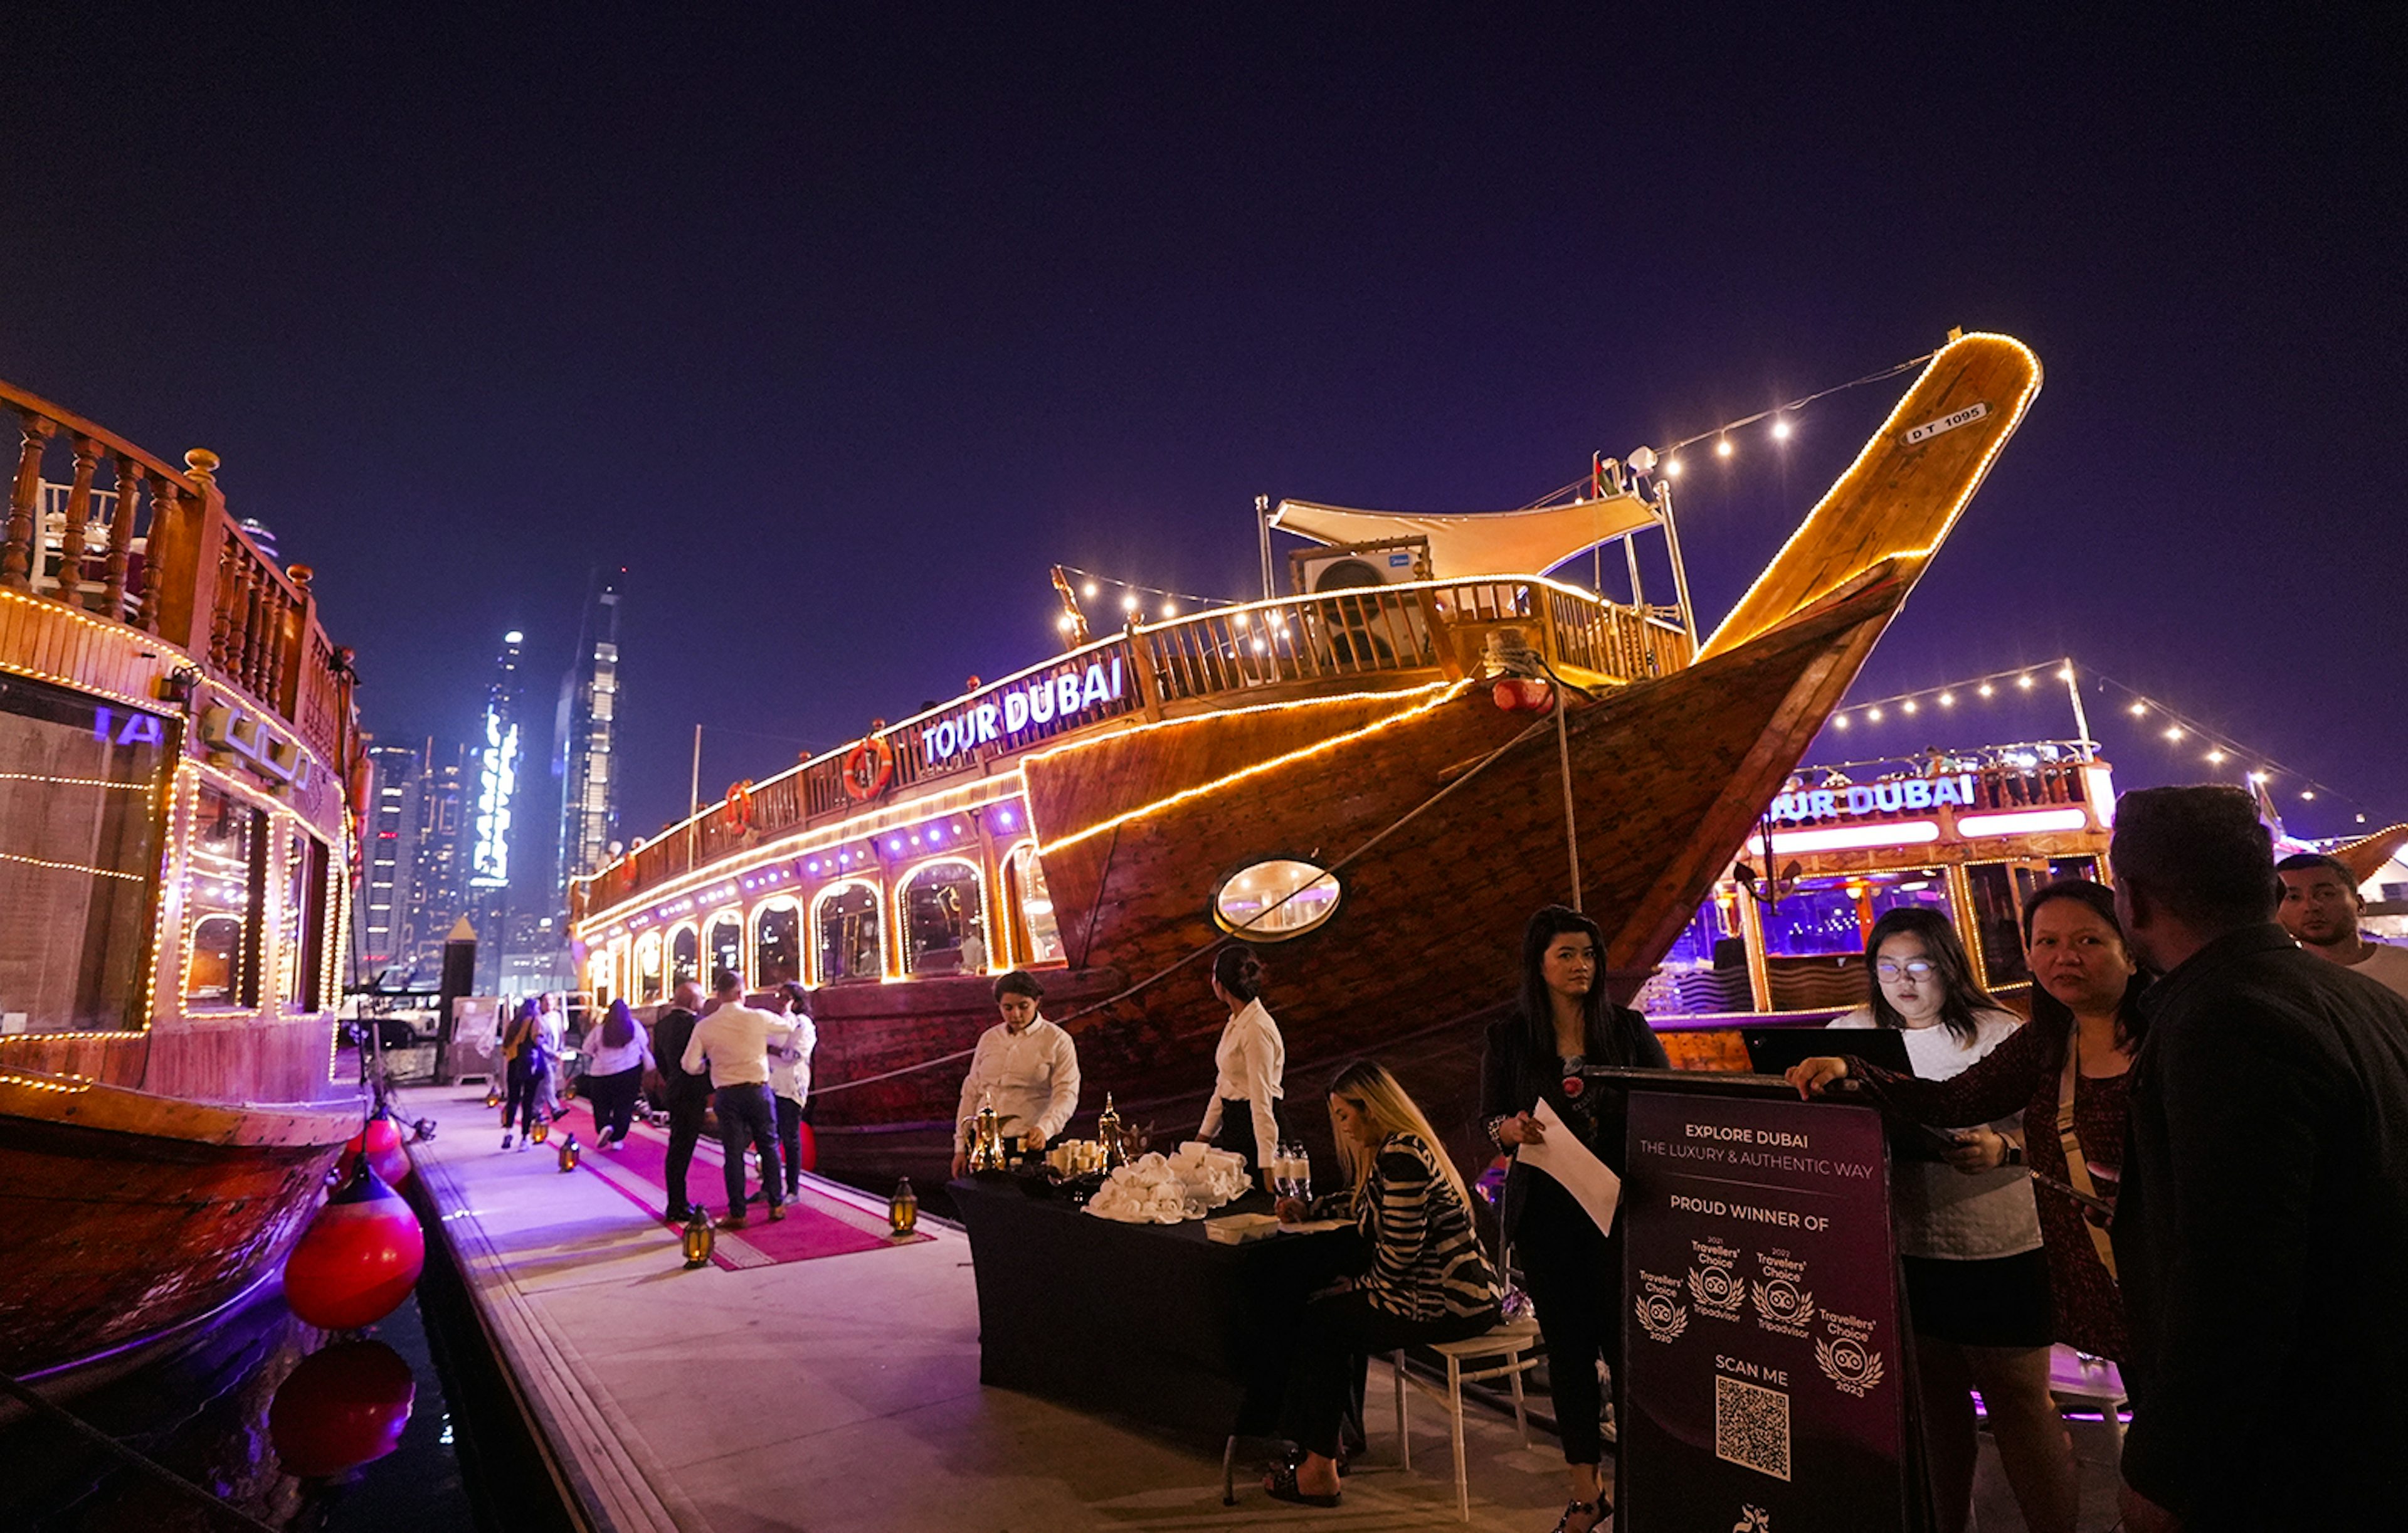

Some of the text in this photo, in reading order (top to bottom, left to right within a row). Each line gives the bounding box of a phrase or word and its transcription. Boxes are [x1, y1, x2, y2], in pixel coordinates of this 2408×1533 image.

[1945, 408, 1980, 427] 1095
[922, 657, 1122, 763] TOUR DUBAI
[1847, 774, 1976, 815] DUBAI
[1686, 1123, 1809, 1149] EXPLORE DUBAI
[1640, 1140, 1874, 1180] THE LUXURY & AUTHENTIC WAY
[1671, 1195, 1830, 1232] PROUD WINNER OF
[1698, 1253, 1734, 1269] Choice
[1763, 1265, 1802, 1283] Choice
[1645, 1282, 1677, 1298] Choice
[1650, 1332, 1672, 1344] 2020
[1758, 1318, 1810, 1339] Tripadvisor
[1827, 1323, 1869, 1342] Choice
[1715, 1354, 1788, 1387] SCAN ME
[1836, 1381, 1865, 1398] 2023
